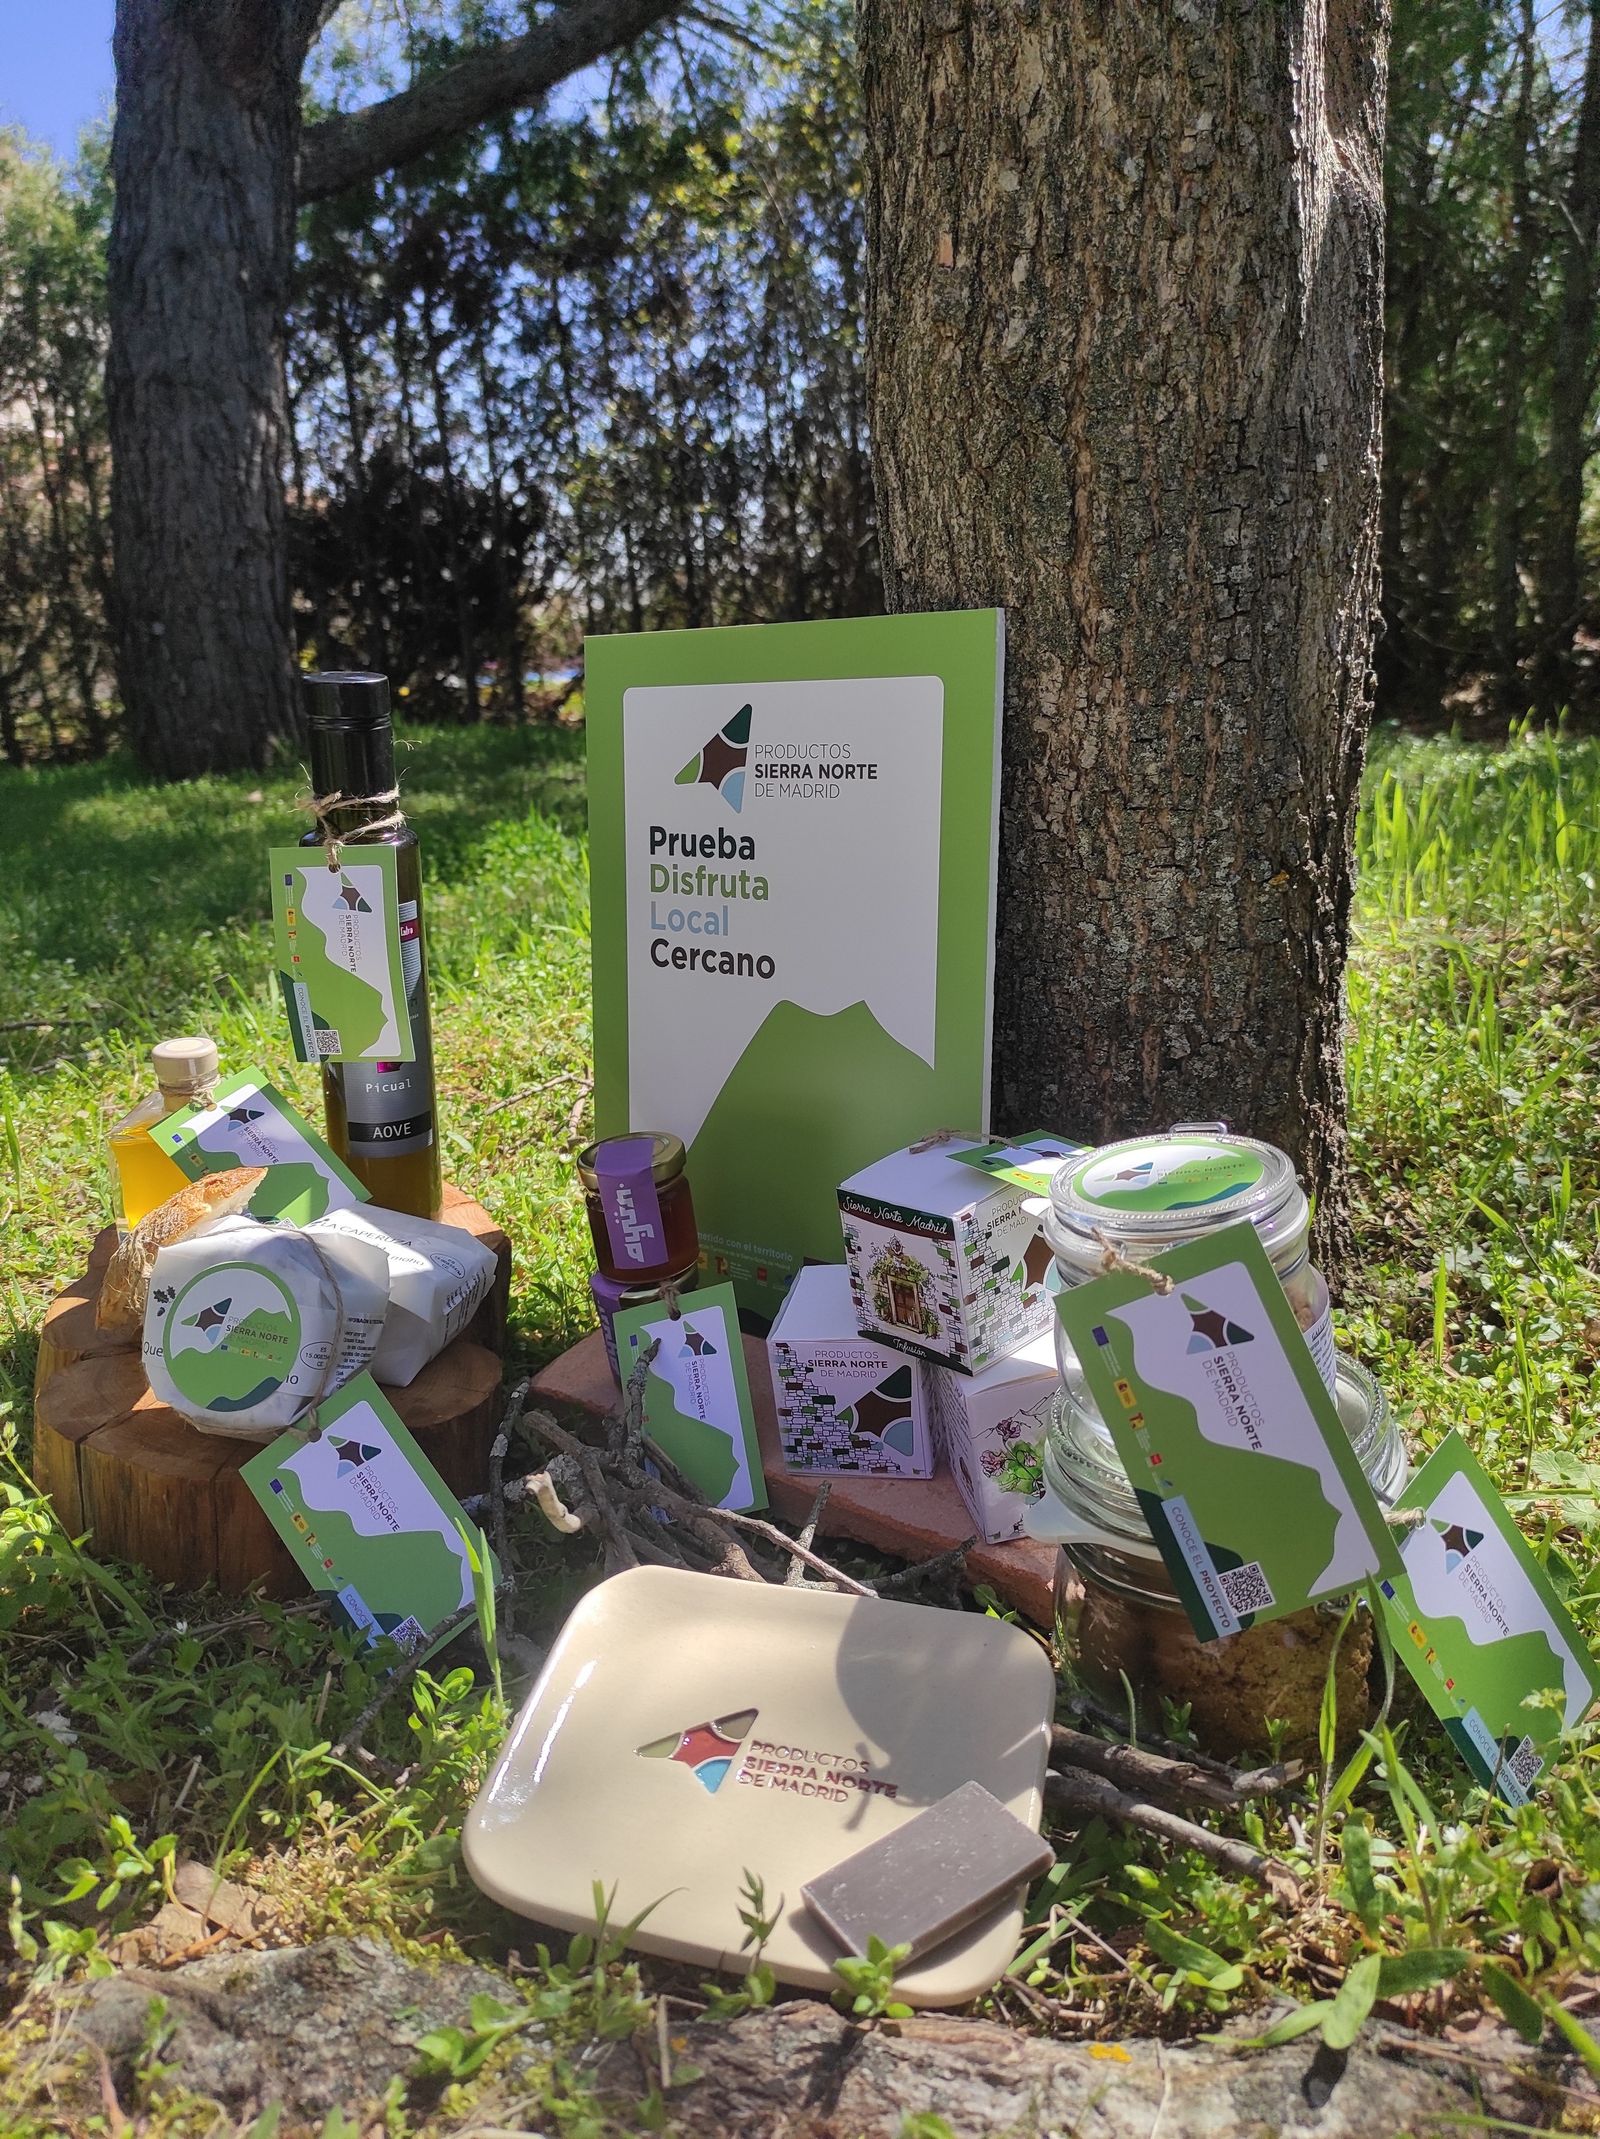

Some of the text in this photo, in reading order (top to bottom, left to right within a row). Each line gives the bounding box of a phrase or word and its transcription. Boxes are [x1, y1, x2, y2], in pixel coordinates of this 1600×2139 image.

[754, 743, 851, 759] PRODUCTOS
[754, 763, 878, 780] SIERRA NORTE
[754, 782, 840, 799] DE MADRID
[649, 825, 756, 861] Prueba
[650, 863, 769, 901] Disfruta
[650, 900, 729, 936] Local
[345, 914, 357, 973] SIERRA NORTE
[650, 937, 776, 979] Cercano
[297, 987, 308, 1015] CONOCE
[304, 1024, 316, 1058] PROYECTO
[365, 1078, 412, 1093] Picual
[243, 1126, 280, 1165] SIERRA NORTE
[372, 1121, 412, 1139] AOVE
[842, 1196, 948, 1236] Sierra Norte Madrid
[986, 1209, 1018, 1231] SIERRA
[991, 1191, 1035, 1217] PRODUCTO
[725, 1238, 742, 1249] con
[743, 1242, 752, 1252] el
[752, 1244, 793, 1263] territorio
[996, 1225, 1009, 1238] DE
[225, 1324, 289, 1345] SIERRA NORTE
[807, 1359, 889, 1369] SIERRA NORTE
[814, 1350, 880, 1360] PRODUCTOS
[820, 1369, 878, 1379] DE MADRID
[691, 1360, 706, 1420] SIERRA NORTE
[1201, 1359, 1239, 1427] DE MADRID
[1213, 1355, 1263, 1451] SIERRA NORTE
[1225, 1351, 1265, 1427] PRODUCTOS
[349, 1476, 381, 1520] DE MADRID
[356, 1471, 401, 1532] SIERRA NORTE
[364, 1464, 399, 1514] PRODUCTOS
[1171, 1505, 1231, 1629] CONOCE EL PROYECTO
[1469, 1554, 1507, 1614] PRODUCTOS
[345, 1593, 370, 1626] CONOCE
[1458, 1571, 1492, 1624] DE MADRID
[1464, 1562, 1510, 1637] SIERRA NORTE
[750, 1739, 872, 1774] PRODUCTOS
[1469, 1718, 1493, 1755] CONOCE
[1499, 1768, 1524, 1807] ROYECTO
[735, 1768, 850, 1804] DE MADRID
[743, 1755, 899, 1799] SIERRA NORTE
